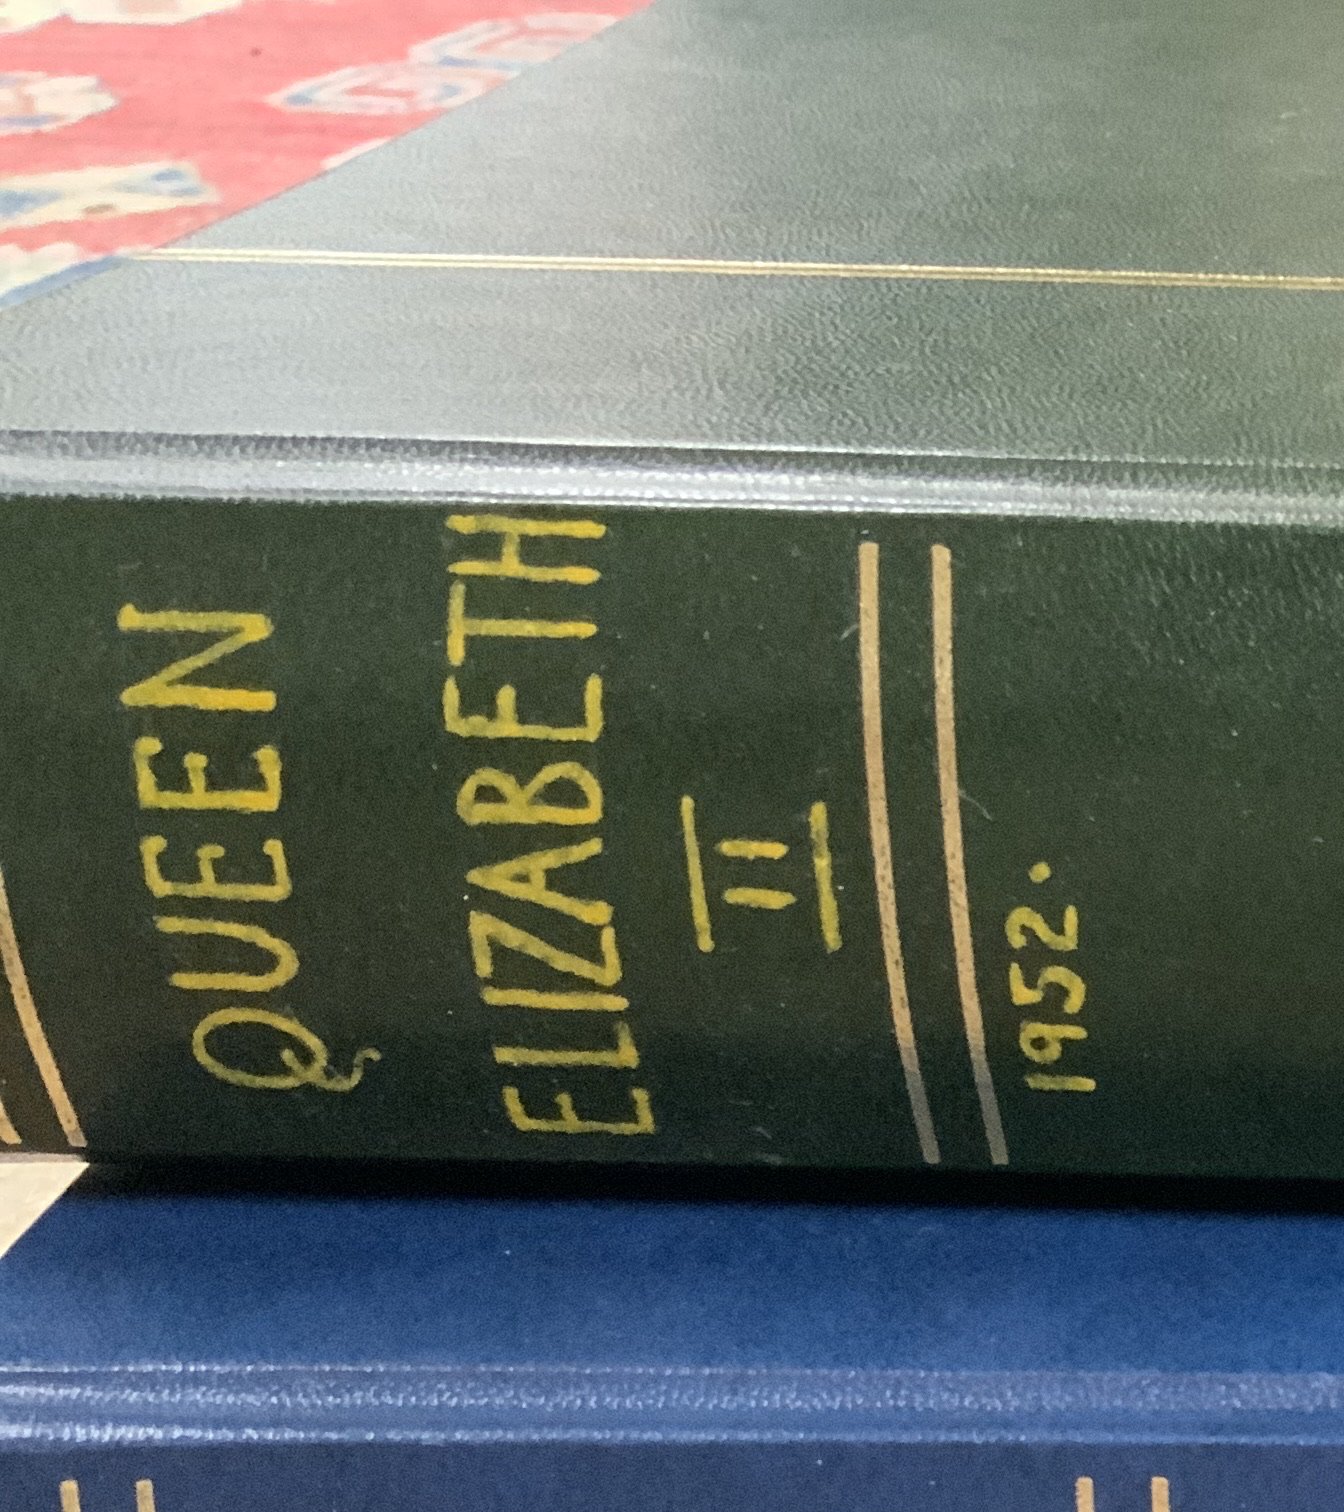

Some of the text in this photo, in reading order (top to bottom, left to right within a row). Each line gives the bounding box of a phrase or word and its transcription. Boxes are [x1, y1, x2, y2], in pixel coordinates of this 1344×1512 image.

[116, 602, 381, 1092] QUEEN
[442, 513, 656, 1136] ELIZABETH
[680, 794, 843, 953] II
